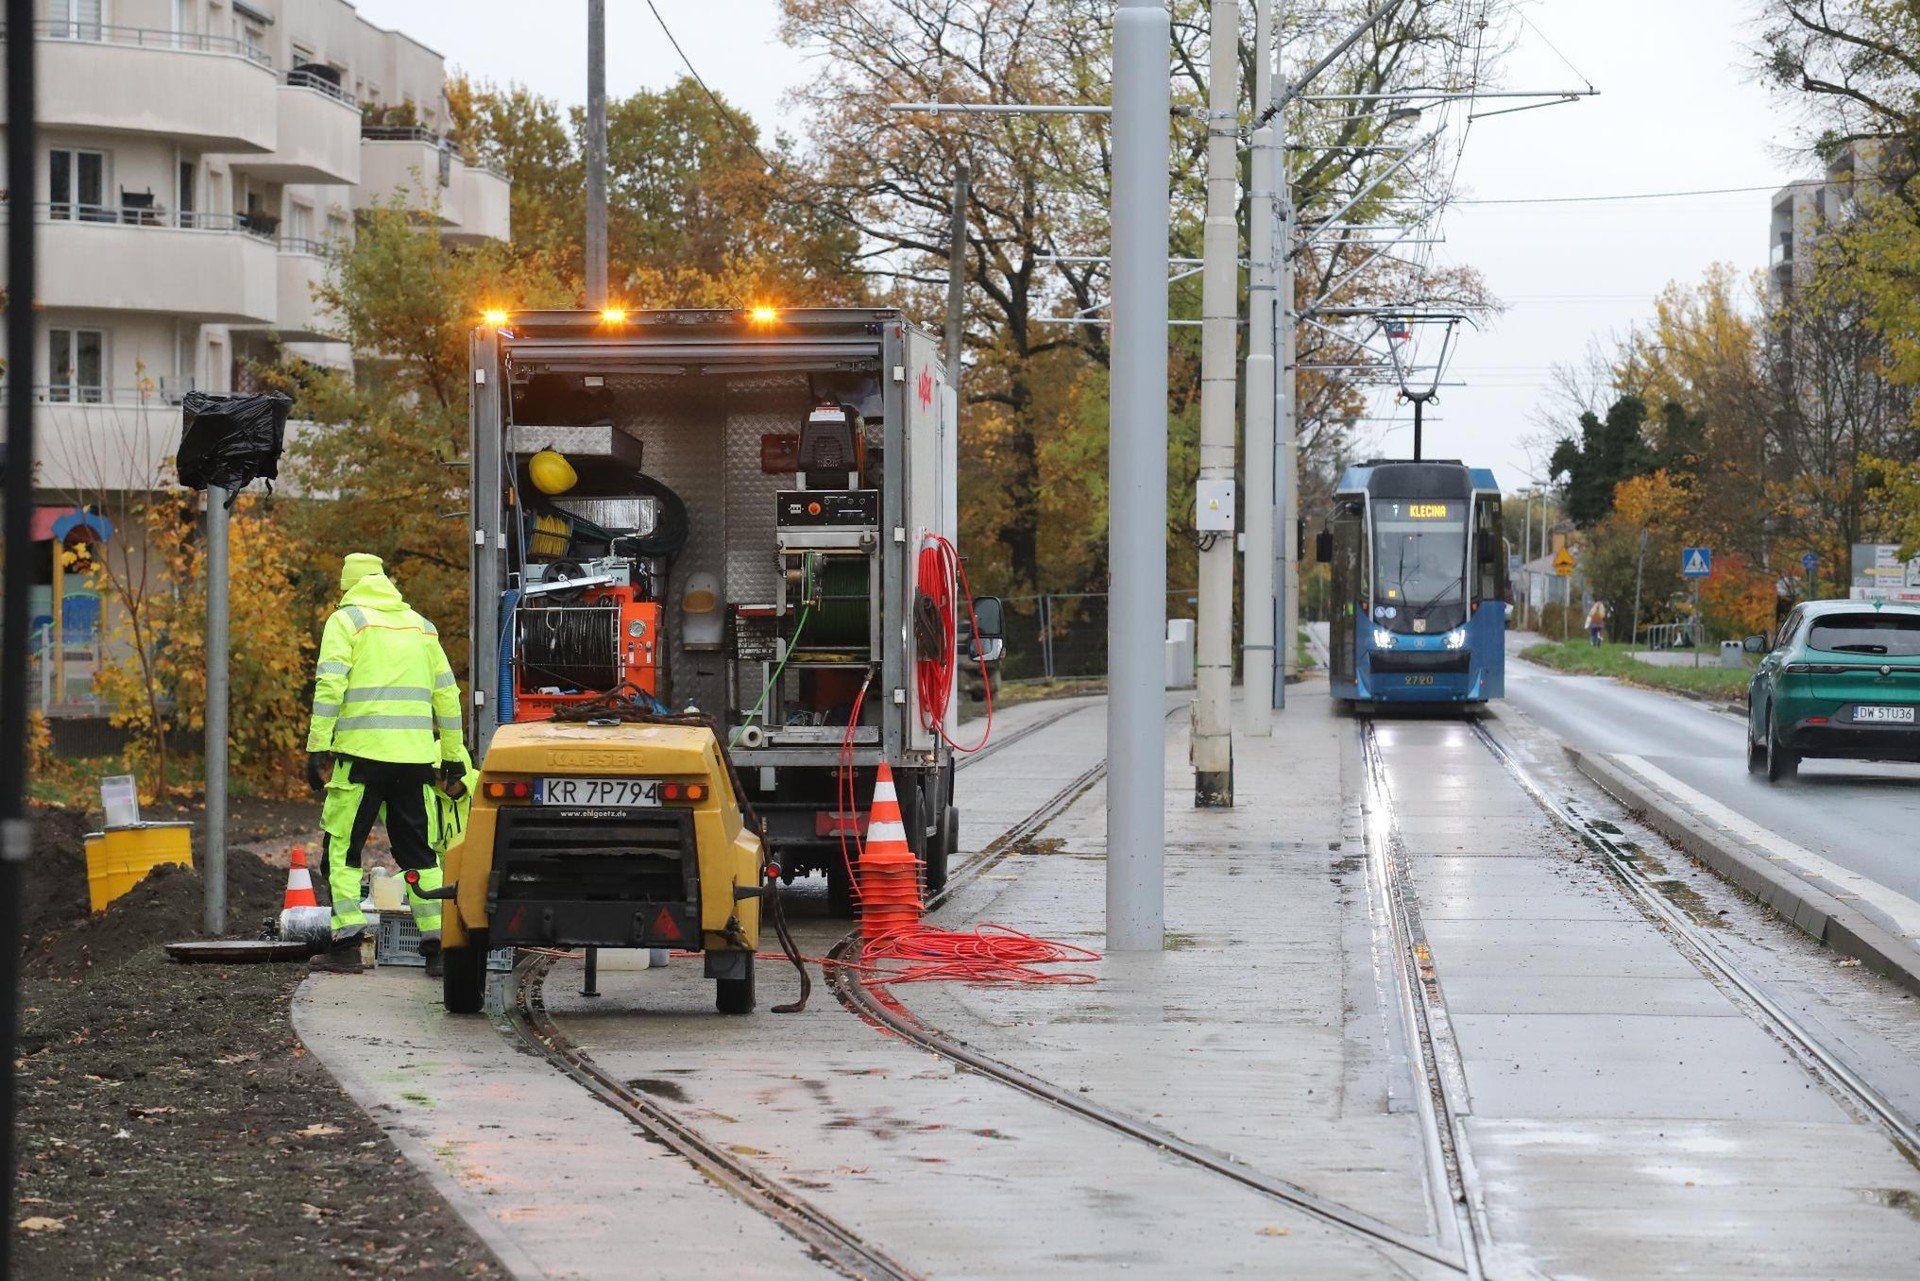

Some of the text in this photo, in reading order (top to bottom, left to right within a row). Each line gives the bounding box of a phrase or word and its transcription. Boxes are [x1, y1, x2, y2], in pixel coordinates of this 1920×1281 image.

[1410, 504, 1446, 518] KLECINA
[1405, 675, 1434, 686] 2720
[1860, 707, 1875, 718] DW
[1878, 707, 1912, 720] 5TU36
[546, 751, 645, 768] KAESER
[547, 780, 658, 805] KR 7P794
[560, 809, 627, 819] www.ehlgoetz.de
